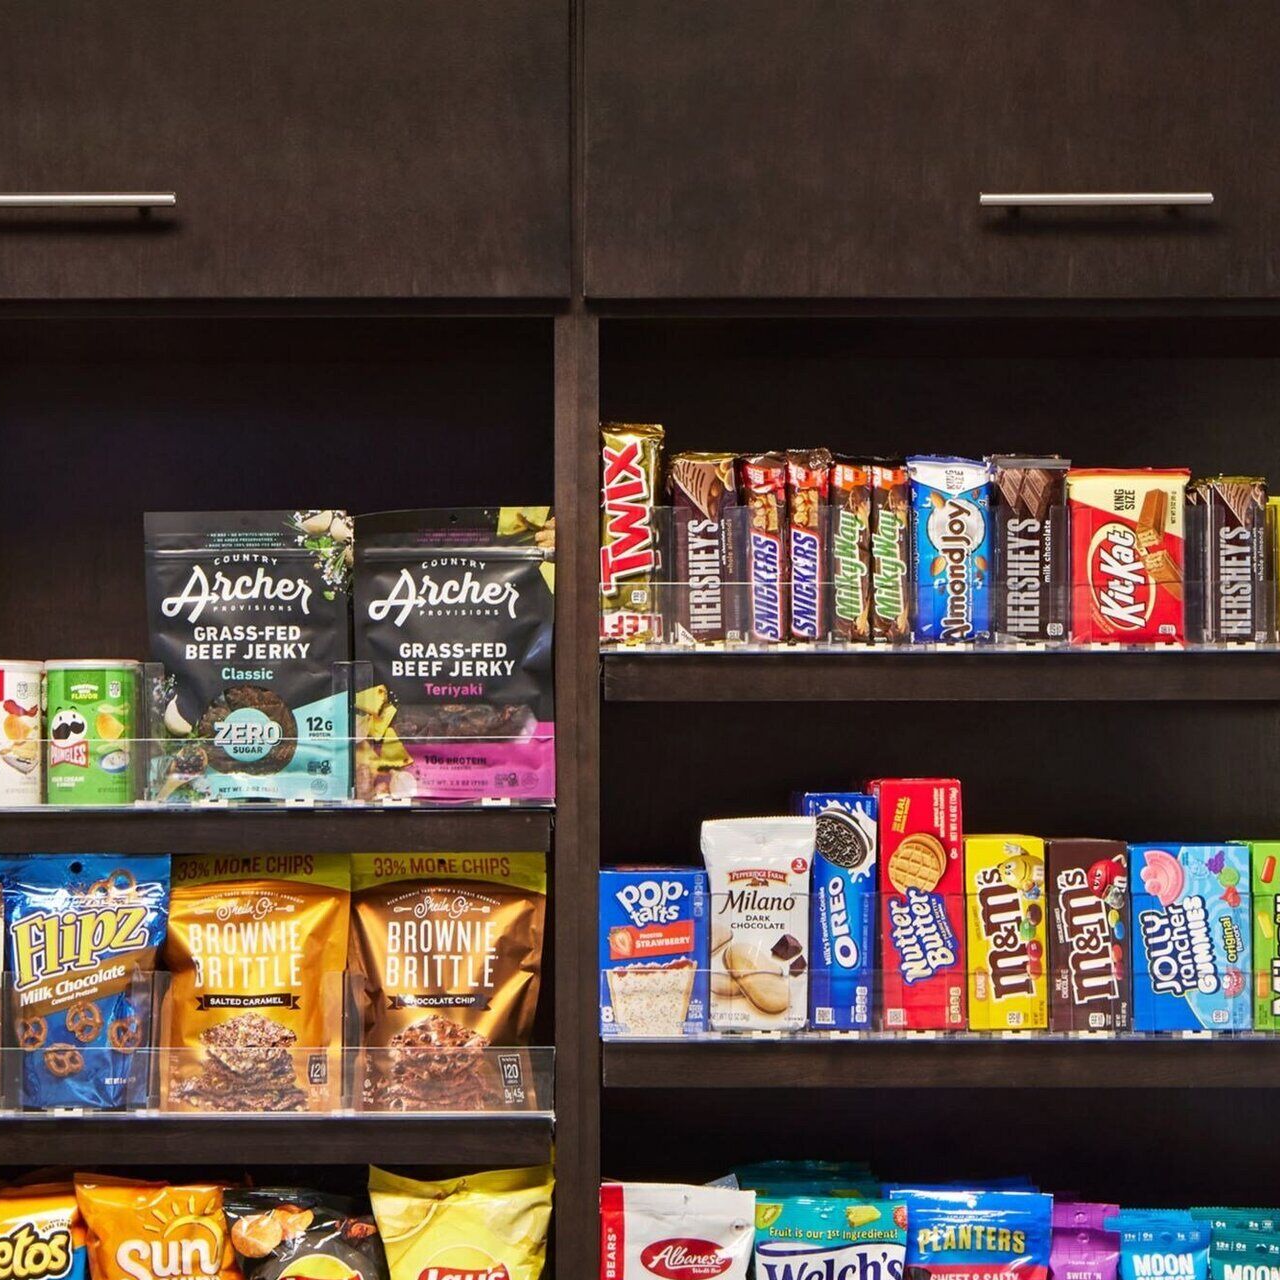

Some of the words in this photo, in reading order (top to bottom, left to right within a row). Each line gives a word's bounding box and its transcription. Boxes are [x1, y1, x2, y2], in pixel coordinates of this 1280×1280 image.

[1114, 488, 1124, 511] KING
[1126, 489, 1136, 510] SIZE
[601, 442, 654, 596] TWIX
[948, 500, 970, 549] Joy
[834, 510, 865, 558] Way
[214, 554, 278, 566] COUNTRY
[422, 558, 486, 570] COUNTRY
[689, 519, 720, 629] HERSHEY'S
[753, 531, 779, 639] SNICKERS
[792, 532, 819, 637] SNICKERS
[835, 556, 867, 620] Milky
[1007, 518, 1040, 633] HERSHEY'S
[162, 565, 312, 623] Archer
[213, 604, 292, 612] PROVISIONS
[942, 550, 972, 640] Almond
[193, 625, 301, 641] GRASS-FED
[185, 644, 239, 659] BEEF
[244, 643, 310, 659] JERKY
[399, 642, 507, 658] GRASS-FED
[221, 667, 273, 680] Classic
[392, 661, 443, 677] BEEF
[449, 660, 515, 676] JERKY
[425, 683, 483, 698] Teriyaki
[214, 721, 282, 746] ZERO
[232, 745, 263, 754] SUGAR
[179, 858, 210, 877] 33%
[213, 858, 263, 875] MORE
[266, 856, 314, 875] CHIPS
[719, 889, 796, 914] Milano
[387, 920, 496, 954] BROWNIE
[828, 877, 859, 969] OREO
[908, 889, 955, 969] Butter
[13, 904, 150, 990] Flipz
[188, 920, 302, 955] BROWNIE
[636, 936, 691, 948] STRAWBERRY
[892, 900, 933, 982] Nutter
[193, 954, 303, 987] BRITTLE
[386, 955, 494, 988] BRITTLE
[19, 988, 53, 1007] Milk
[56, 964, 126, 996] Chocolate
[210, 998, 242, 1007] SALTED
[243, 997, 284, 1006] CARAMEL
[918, 1225, 1025, 1253] PLANTERS
[649, 1246, 726, 1268] Albanese
[1132, 1254, 1193, 1275] MOON
